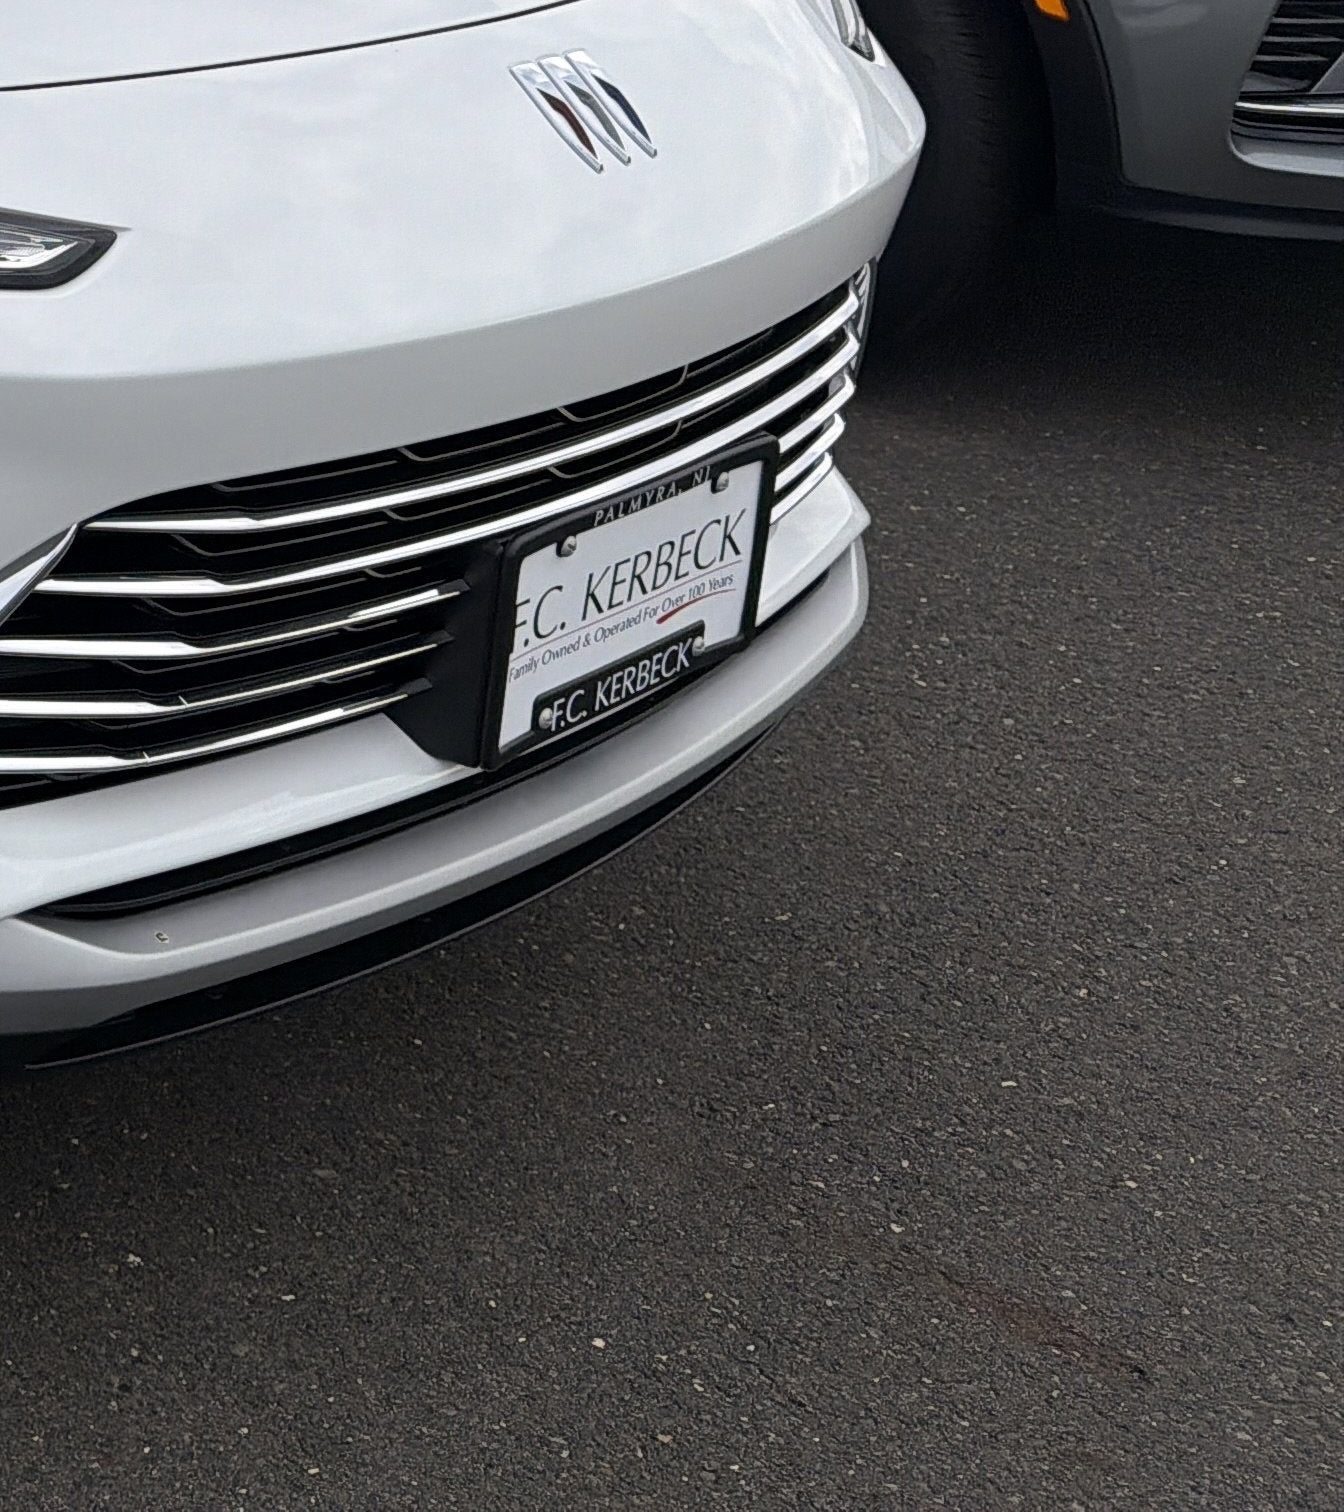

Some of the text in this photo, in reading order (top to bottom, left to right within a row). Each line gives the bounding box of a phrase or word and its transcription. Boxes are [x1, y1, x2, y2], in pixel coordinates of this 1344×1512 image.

[581, 508, 747, 622] KERBECK
[509, 573, 734, 683] Family Owned & Operated For Over 100 Years
[551, 637, 692, 732] F.C. KERBECK
